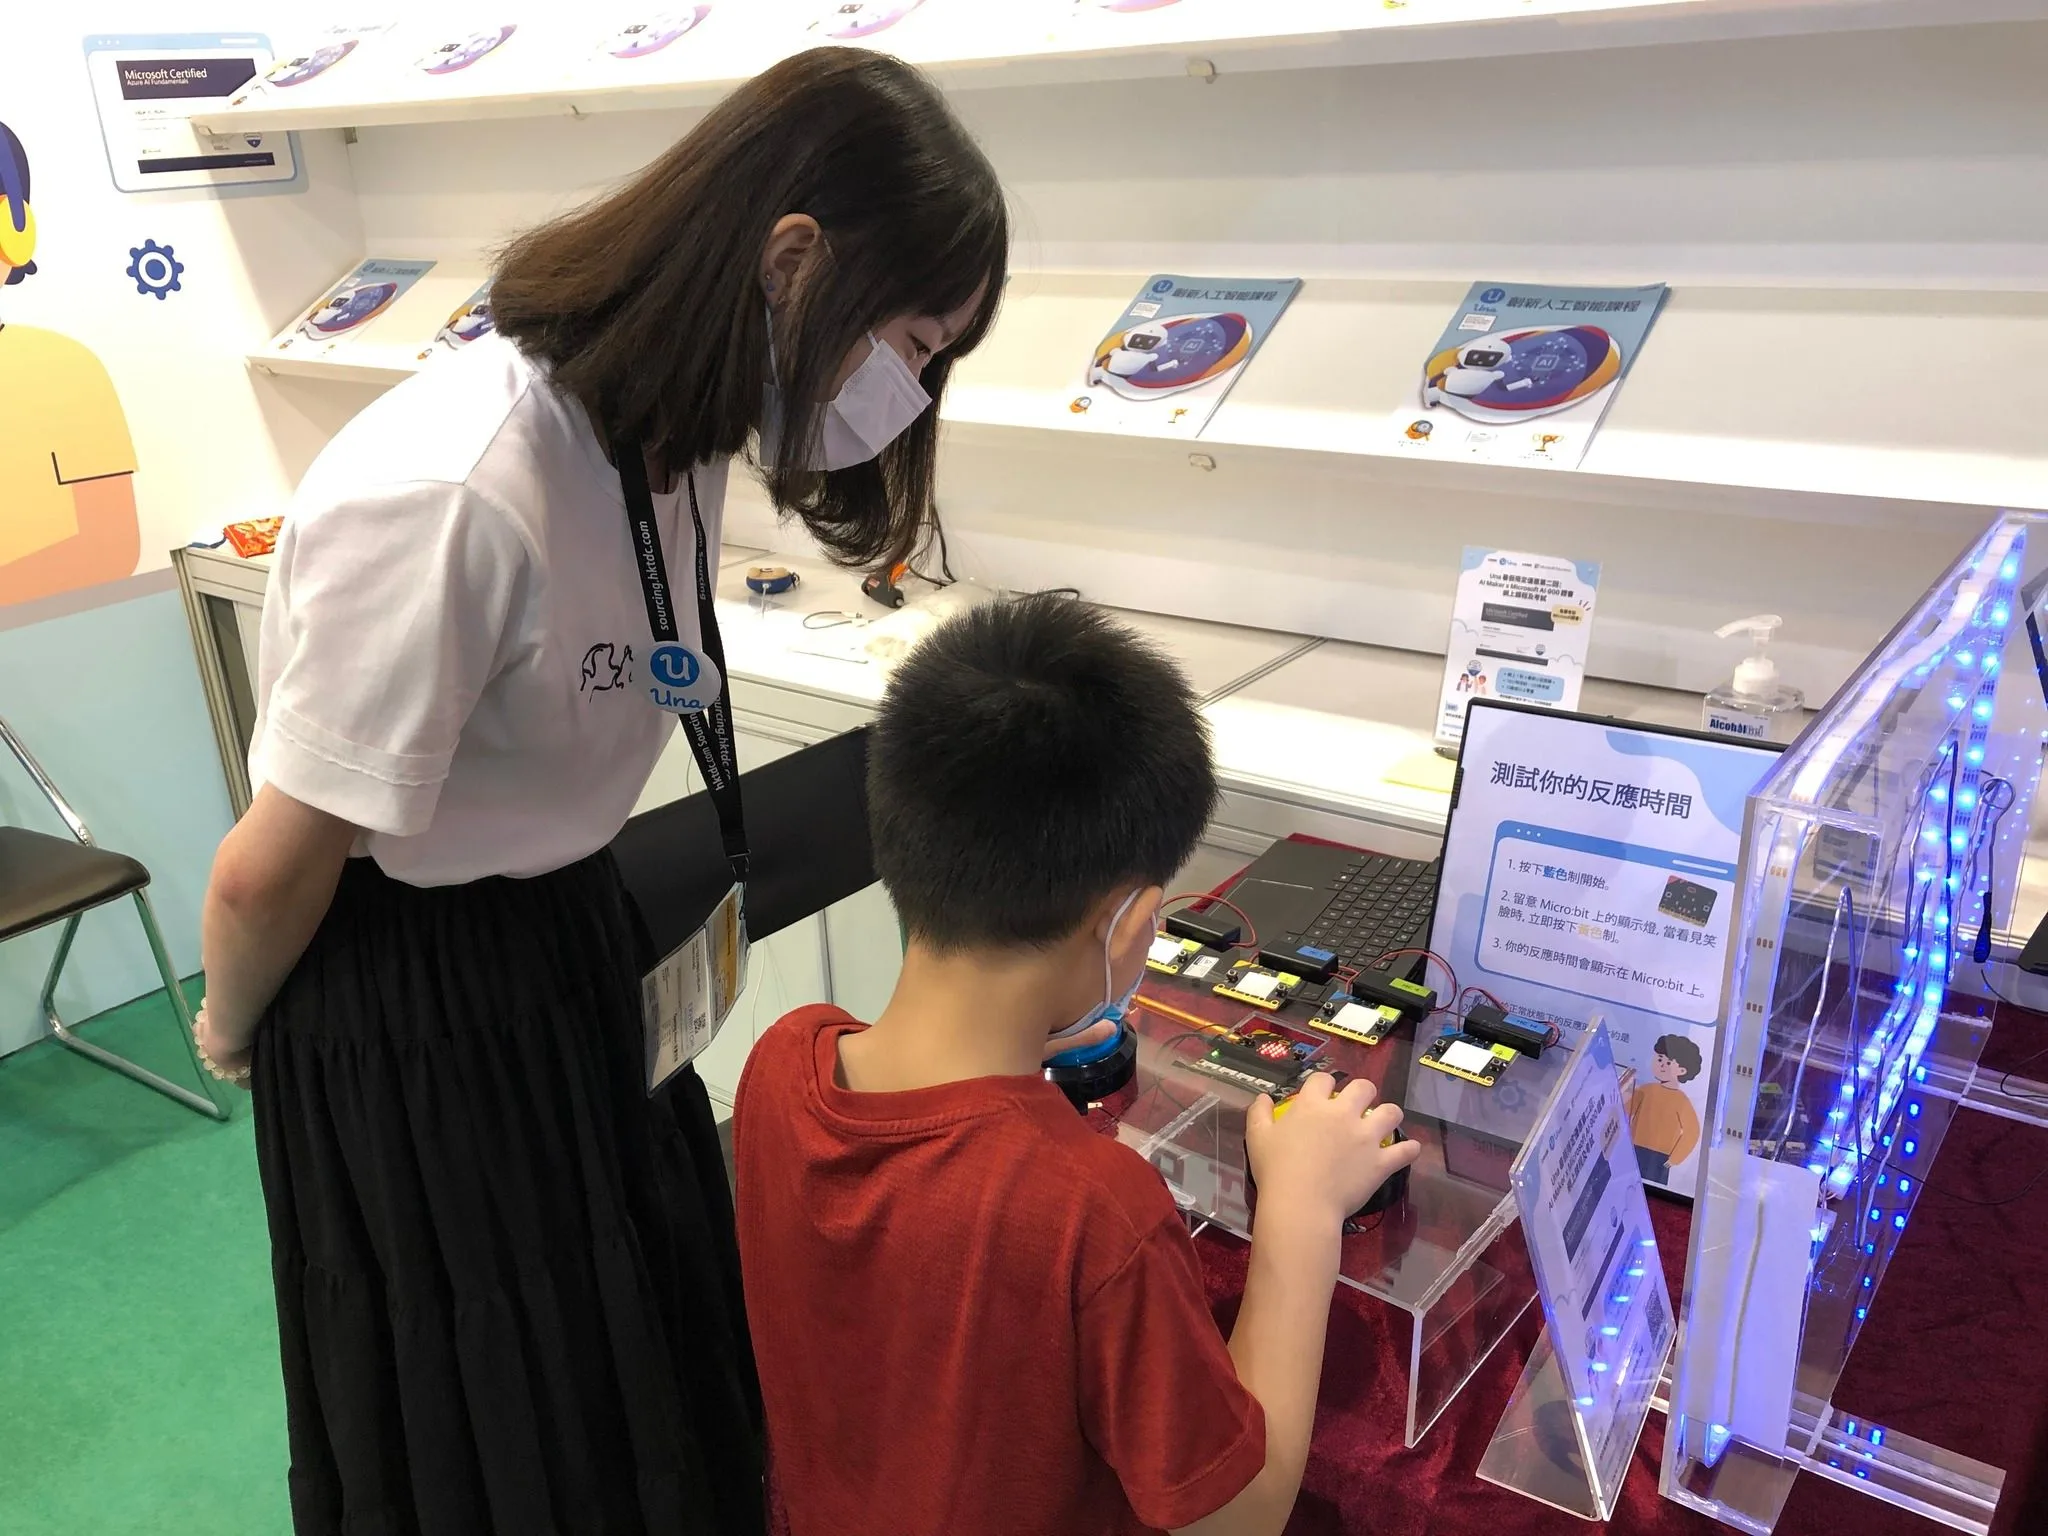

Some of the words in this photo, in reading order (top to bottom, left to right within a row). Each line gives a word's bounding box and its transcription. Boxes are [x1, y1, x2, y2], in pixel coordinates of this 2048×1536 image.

[125, 69, 168, 79] Microsoft
[169, 68, 207, 78] Certified
[640, 520, 669, 631] sourcing.hktdc.com
[1510, 584, 1539, 593] Microsoft
[650, 688, 704, 709] Una
[689, 712, 708, 747] Sourcin
[1490, 761, 1692, 819] 測試你的反應時間
[1508, 859, 1516, 870] 1.
[1501, 890, 1511, 902] 2.
[1513, 892, 1538, 909] 留意
[1540, 899, 1590, 919] Micro:bit
[1492, 937, 1502, 949] 3.
[1505, 939, 1629, 981] 你的反應時間會顯示在
[1631, 970, 1684, 993] Micro:bit
